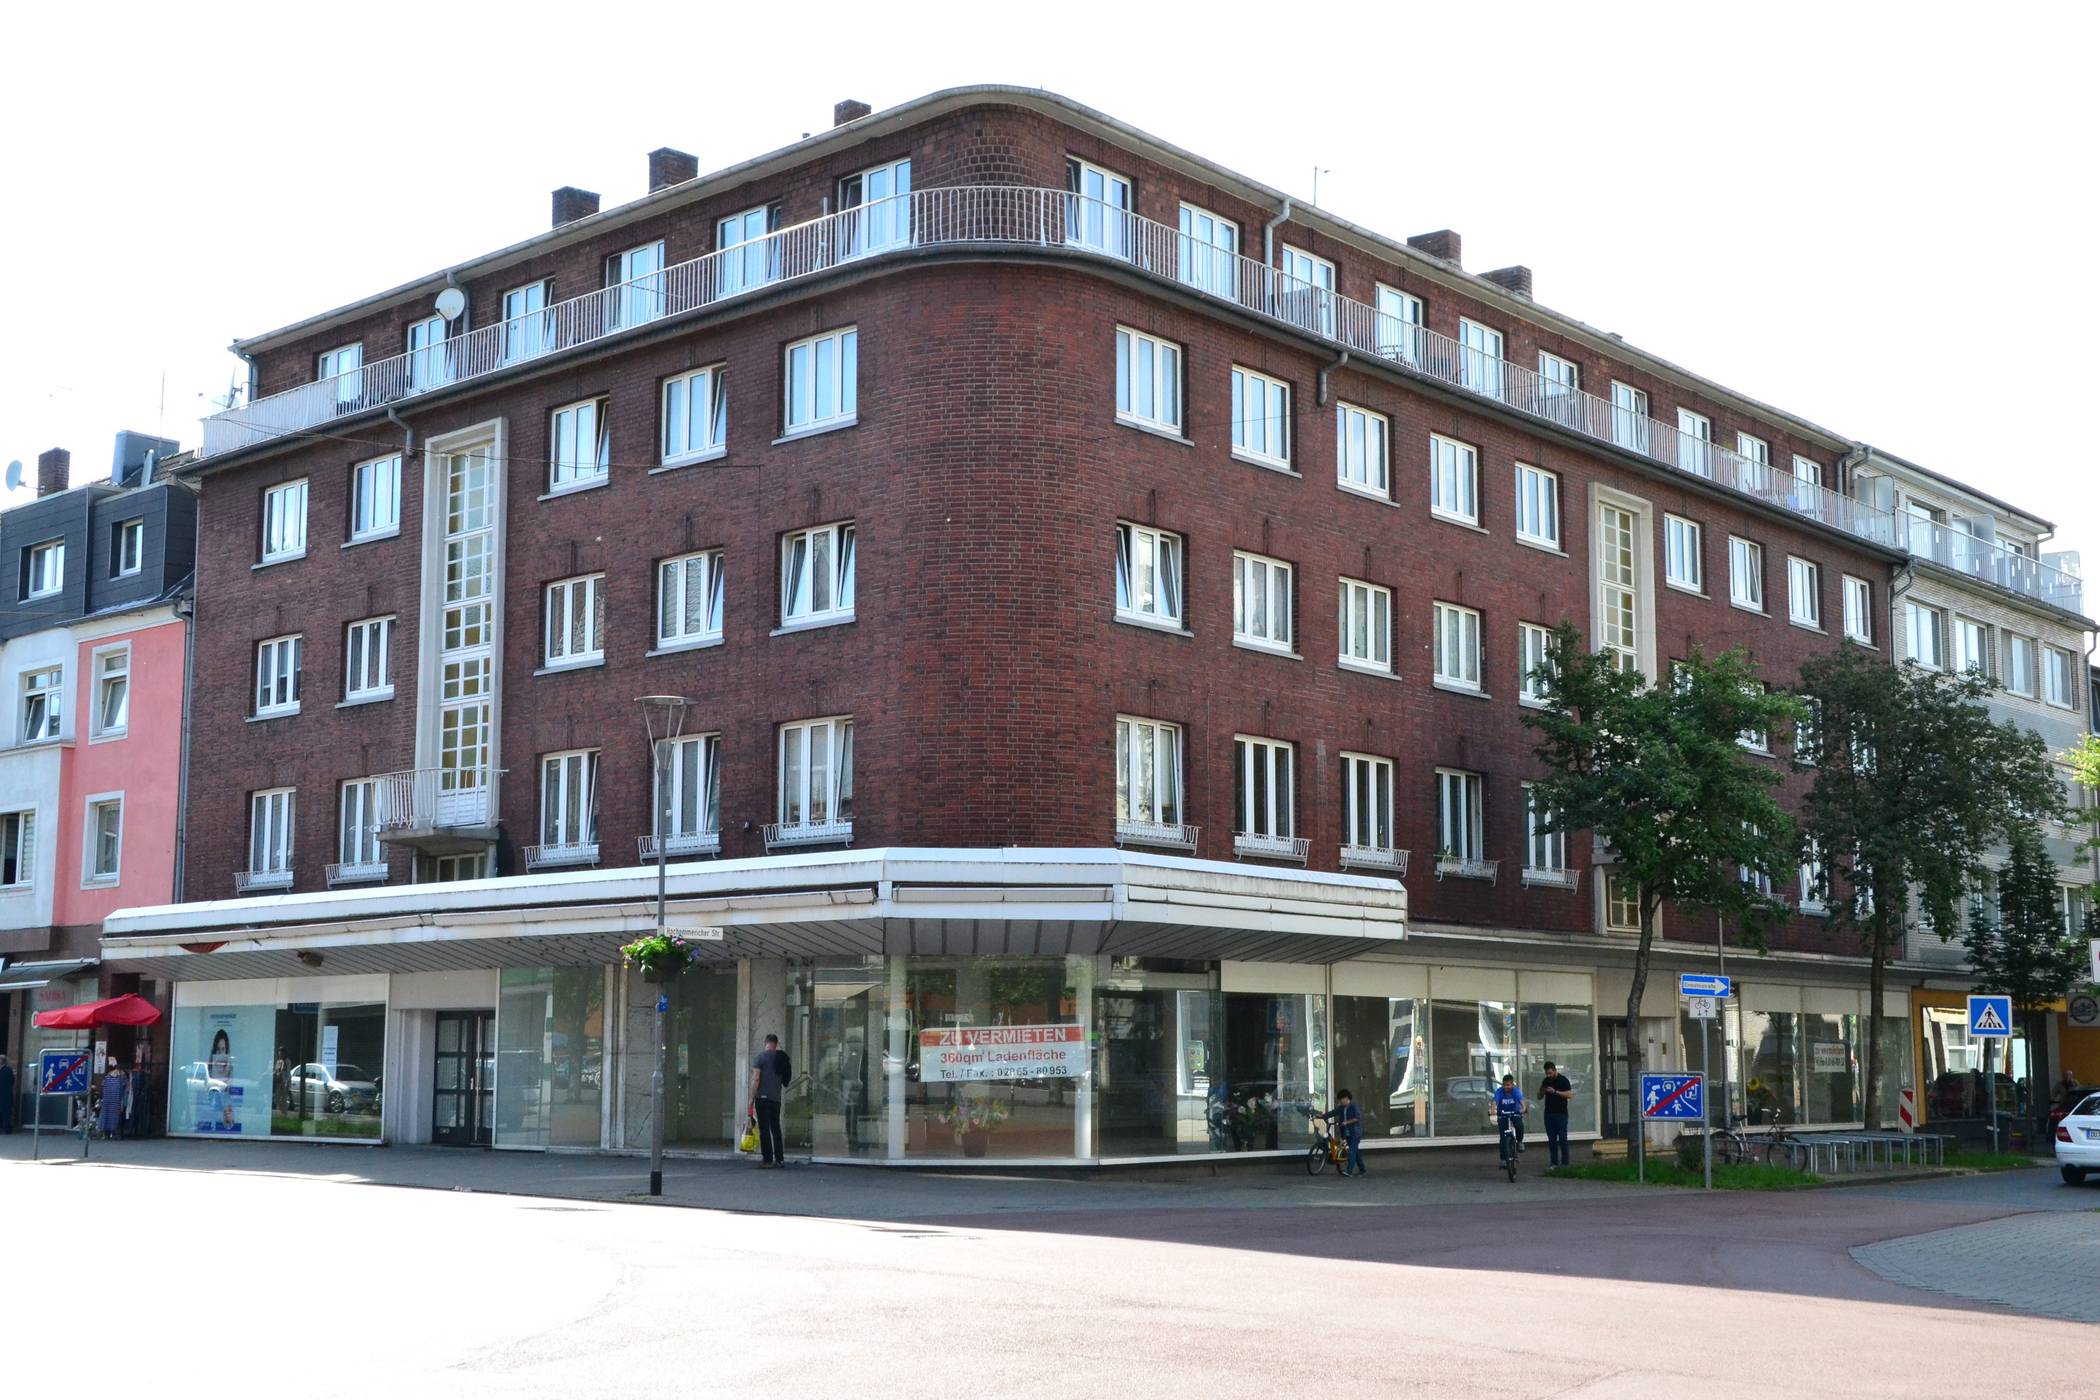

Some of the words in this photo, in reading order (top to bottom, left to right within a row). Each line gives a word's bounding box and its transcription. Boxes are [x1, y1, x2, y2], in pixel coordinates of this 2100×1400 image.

[939, 1031, 962, 1046] ZU
[967, 1028, 1066, 1045] VERMIETEN
[988, 1049, 1066, 1063] Ladenfläche
